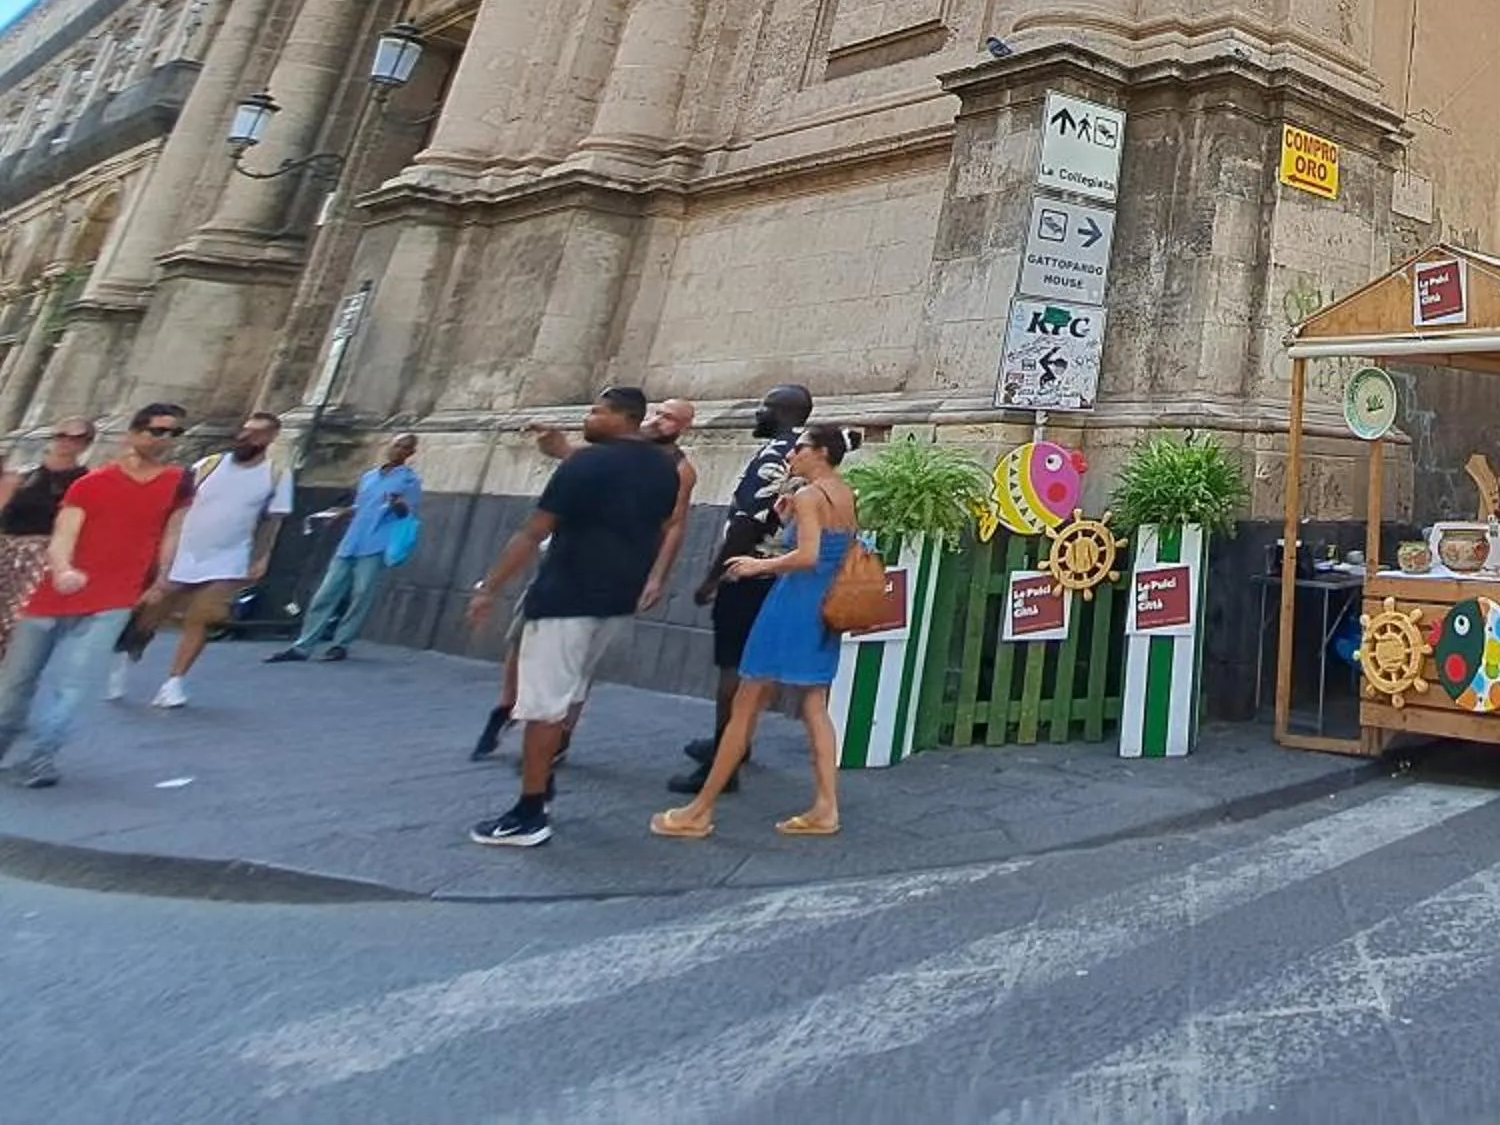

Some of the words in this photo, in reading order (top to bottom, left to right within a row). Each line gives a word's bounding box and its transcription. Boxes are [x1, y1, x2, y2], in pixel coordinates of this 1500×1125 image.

[1286, 129, 1337, 164] COMPRO
[1059, 168, 1115, 191] Collegiata
[1296, 156, 1327, 181] ORO
[1027, 254, 1104, 276] GATTOPARDO
[1043, 274, 1084, 290] HOUSE
